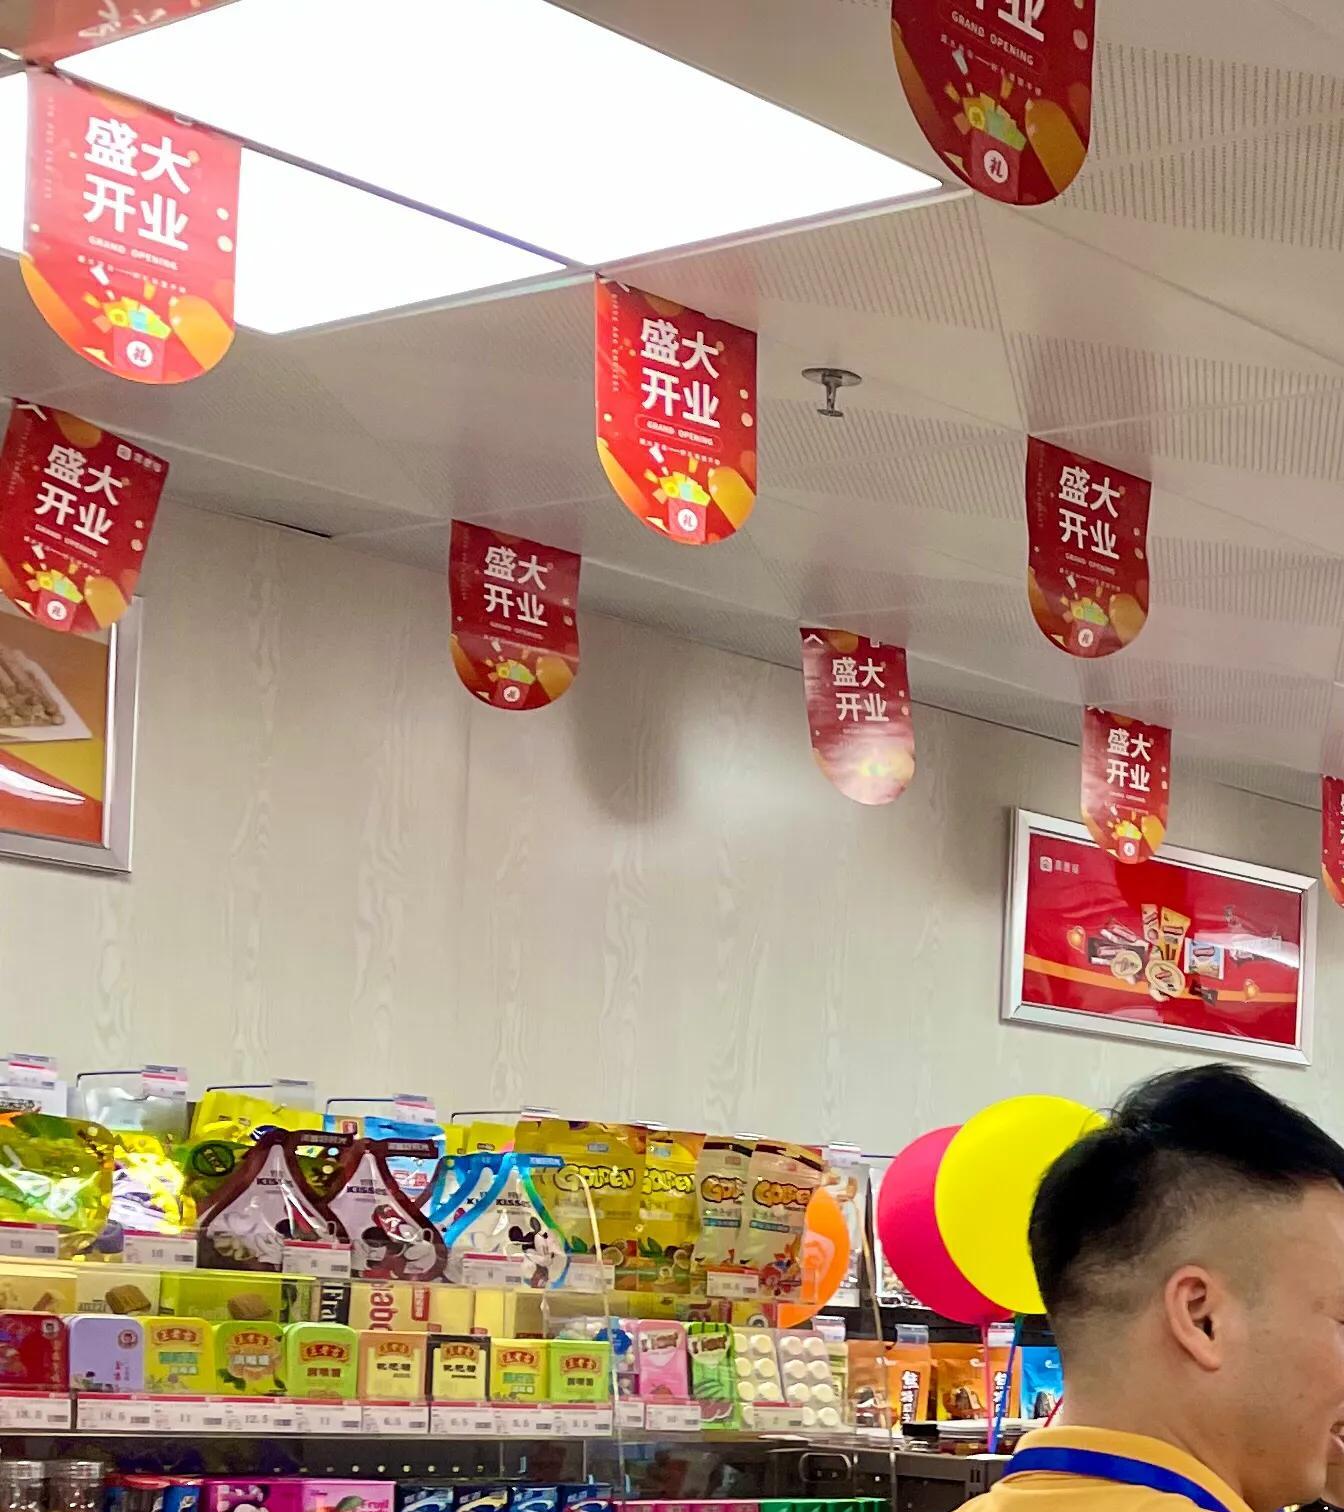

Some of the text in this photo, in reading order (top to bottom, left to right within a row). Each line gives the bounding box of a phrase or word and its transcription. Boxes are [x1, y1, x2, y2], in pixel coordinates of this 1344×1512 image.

[951, 10, 985, 38] GRAND
[989, 33, 1034, 66] OPENING
[84, 116, 192, 195] 盛大
[988, 154, 1006, 181] 礼
[83, 174, 189, 252] 开业
[640, 318, 720, 379] 盛大
[641, 367, 720, 429] 开业
[47, 443, 123, 506] 盛大
[1059, 465, 1120, 519] 盛大
[35, 481, 112, 546] 开业
[1059, 509, 1120, 561] 开业
[485, 546, 548, 590] 盛大
[483, 583, 548, 628] 开业
[832, 656, 885, 689] 盛大
[836, 692, 889, 722] 开业
[1108, 728, 1152, 762] 盛大
[1107, 758, 1150, 792] 开业
